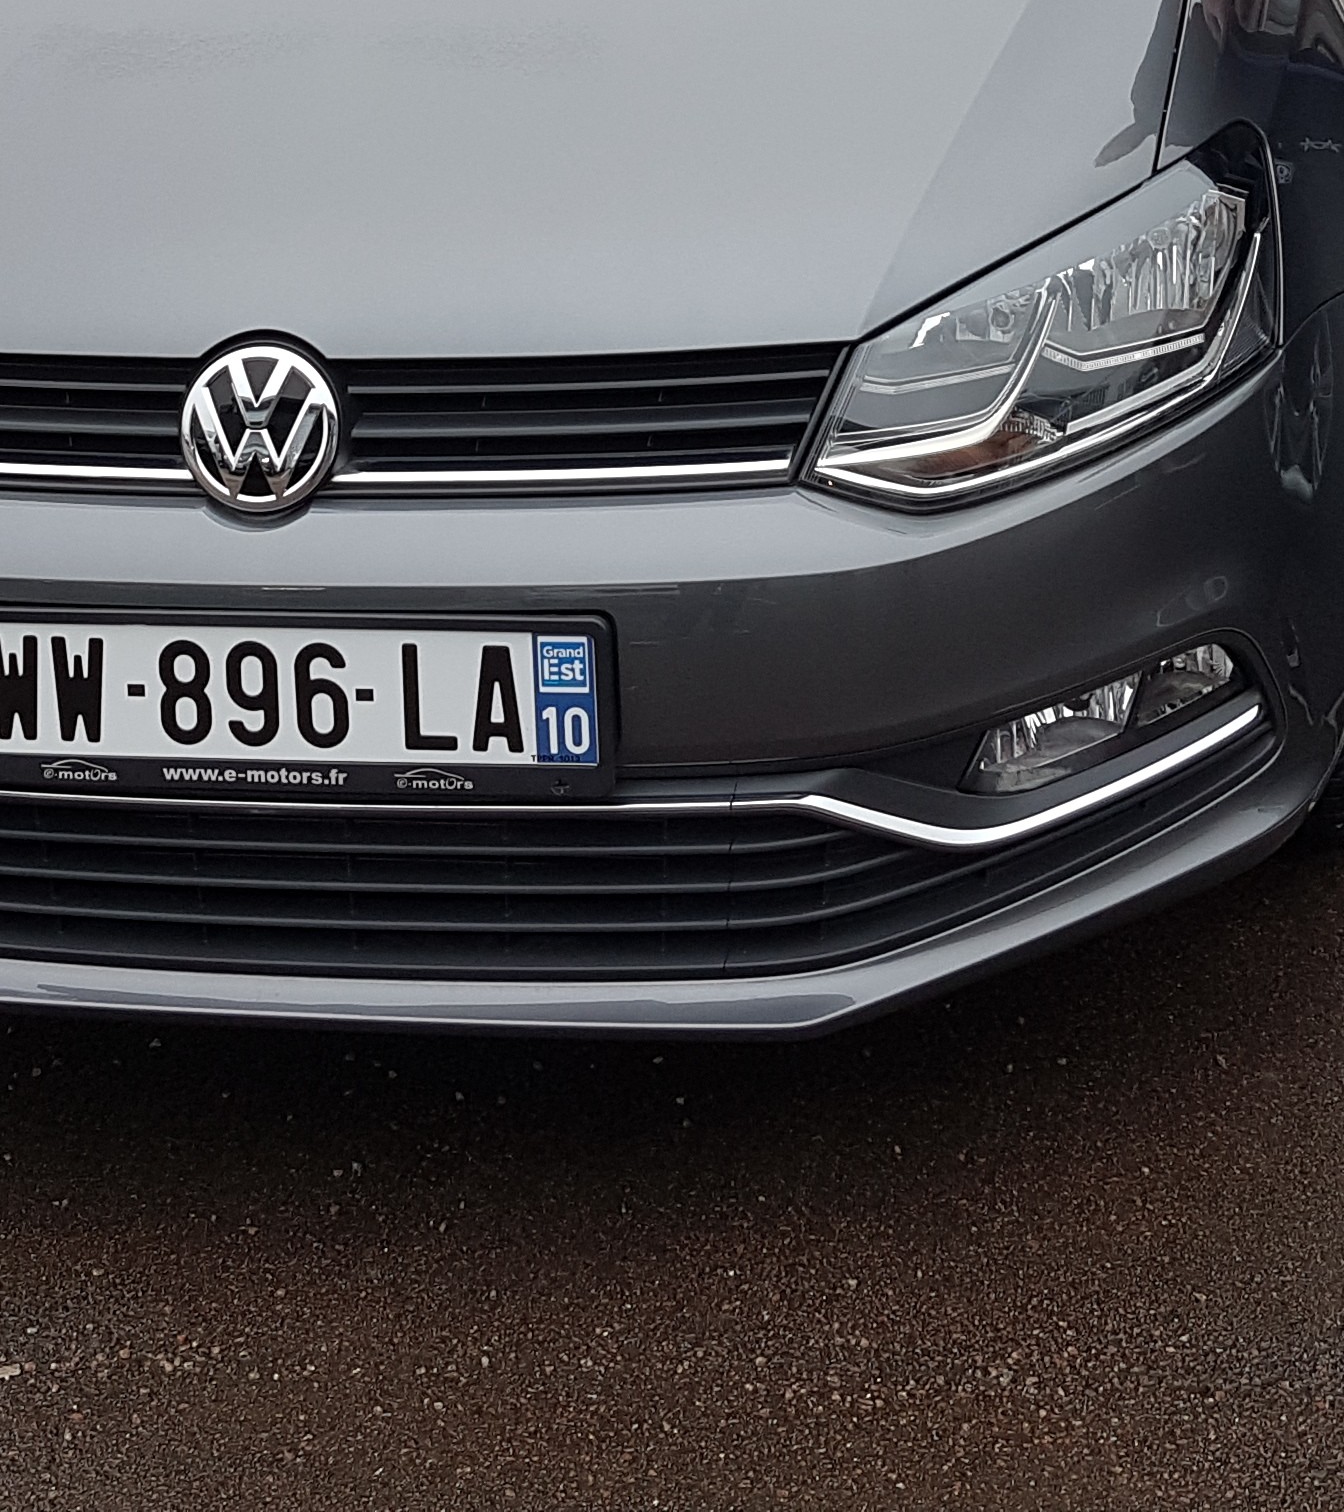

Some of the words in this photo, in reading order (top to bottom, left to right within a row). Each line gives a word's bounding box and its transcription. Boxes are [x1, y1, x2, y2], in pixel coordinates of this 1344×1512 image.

[542, 646, 584, 658] Grand
[542, 659, 585, 681] Est
[541, 706, 591, 755] 10
[162, 767, 348, 786] www.e-motors.fr
